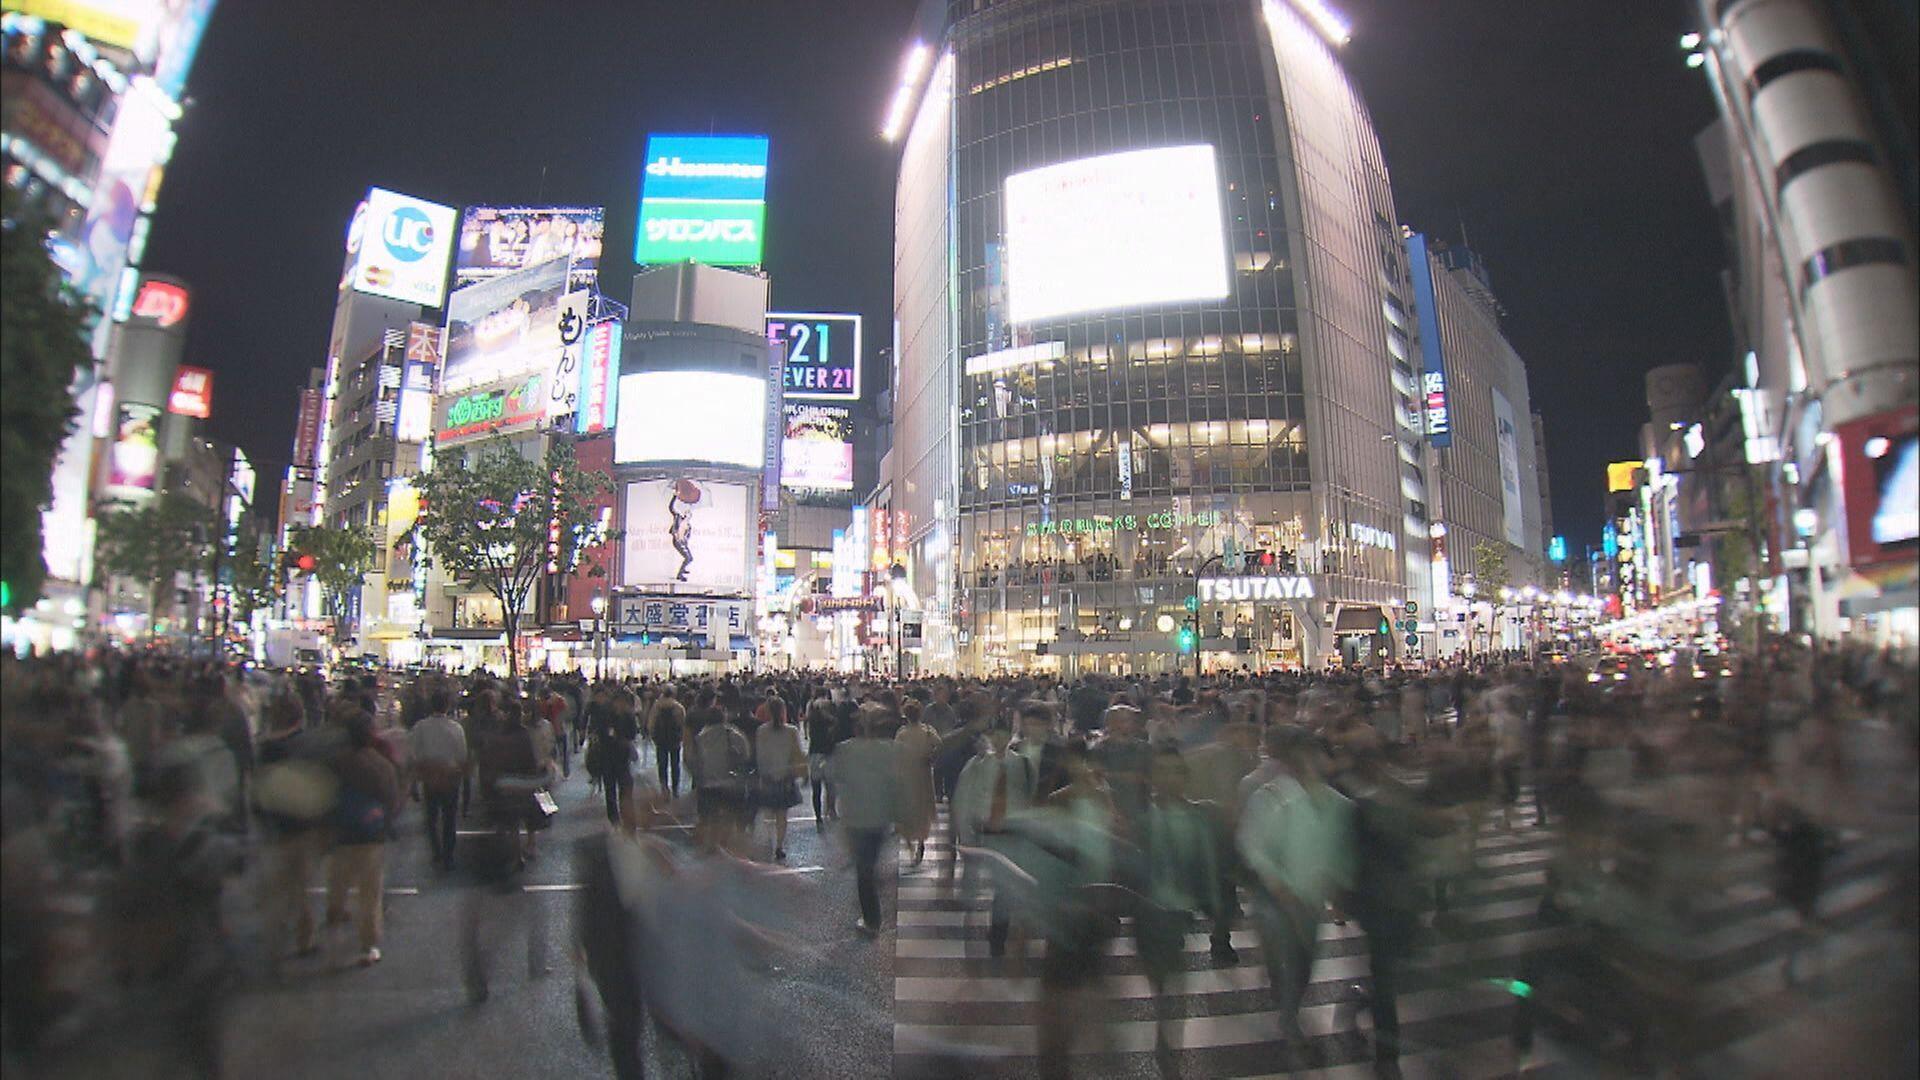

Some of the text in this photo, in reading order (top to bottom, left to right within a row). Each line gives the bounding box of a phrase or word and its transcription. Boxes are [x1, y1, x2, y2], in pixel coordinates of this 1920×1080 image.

[645, 218, 757, 242] サロンパス
[832, 367, 853, 389] 21
[1424, 372, 1449, 434] SEIBU
[1199, 577, 1315, 600] TSUTAYA
